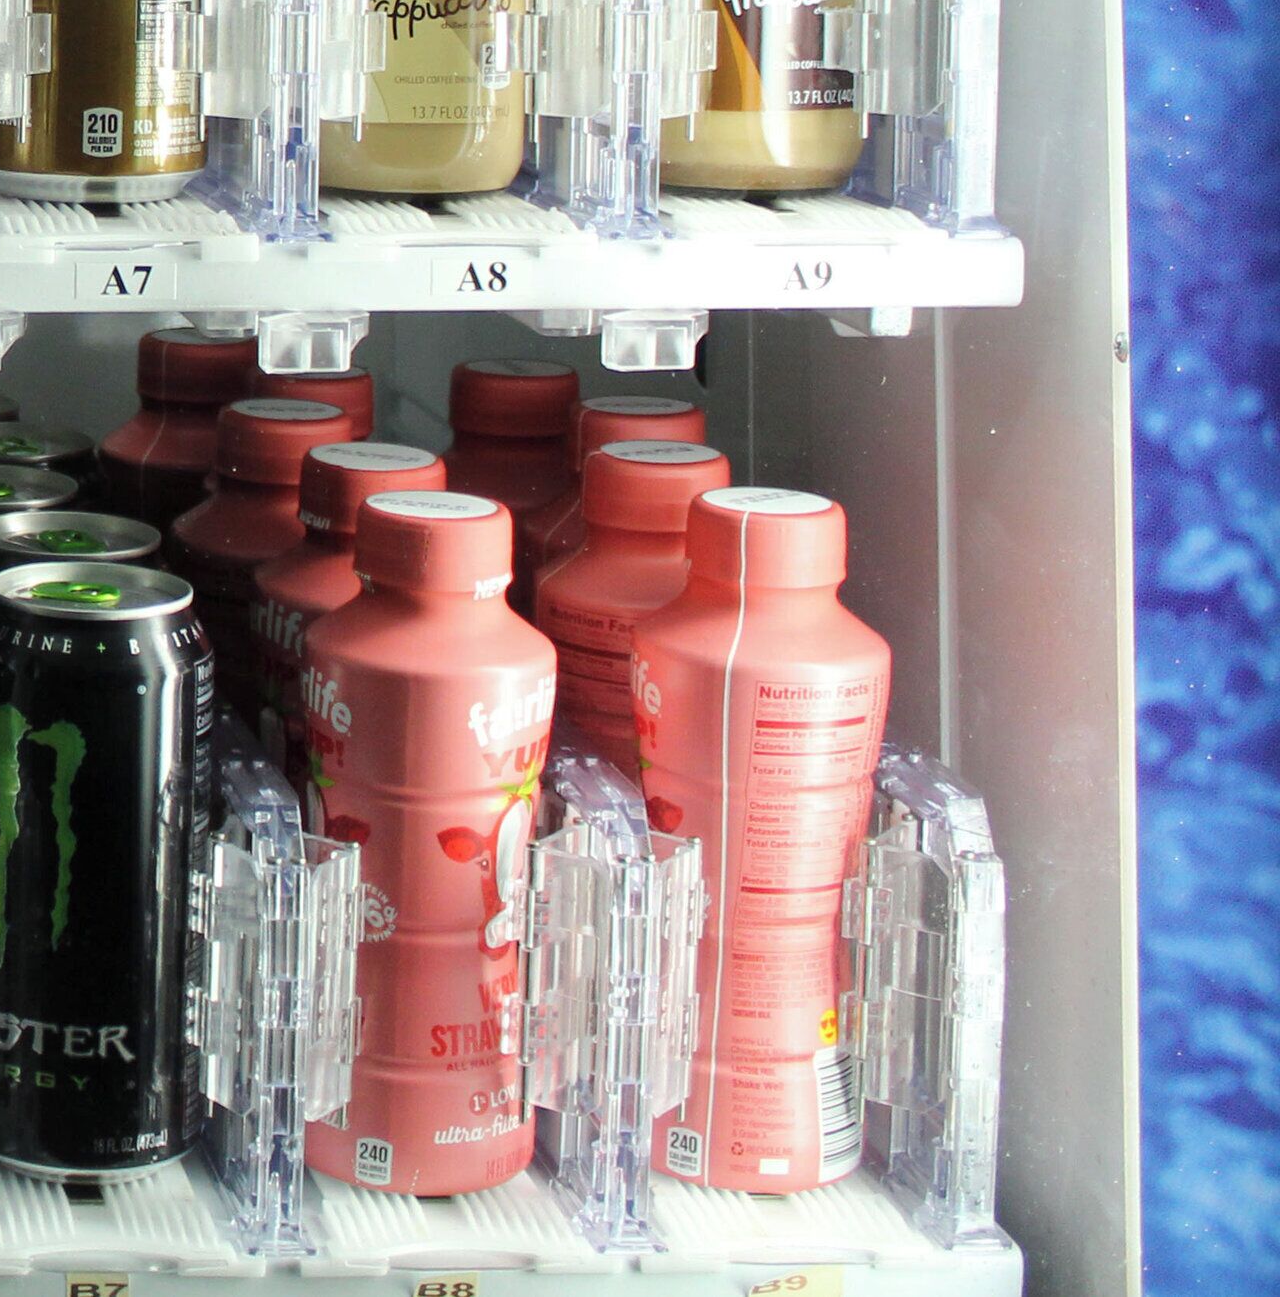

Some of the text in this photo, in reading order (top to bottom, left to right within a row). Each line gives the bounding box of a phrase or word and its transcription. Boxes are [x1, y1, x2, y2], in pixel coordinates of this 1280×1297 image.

[394, 75, 453, 84] CHILLED COFFEE
[812, 91, 823, 104] FL
[824, 90, 837, 103] OZ
[412, 106, 468, 118] 13.7 FL OZ
[87, 113, 118, 134] 210
[87, 136, 117, 145] CALORIES
[101, 265, 153, 295] A7
[457, 261, 507, 292] A8
[785, 261, 831, 291] A9
[128, 638, 141, 655] B
[300, 666, 352, 734] rlife
[759, 682, 869, 701] Nutrition Facts
[468, 673, 555, 748] fairli
[434, 1113, 520, 1145] ultra-filte
[359, 1142, 388, 1163] 240
[670, 1132, 698, 1153] 240
[70, 1283, 128, 1297] B7
